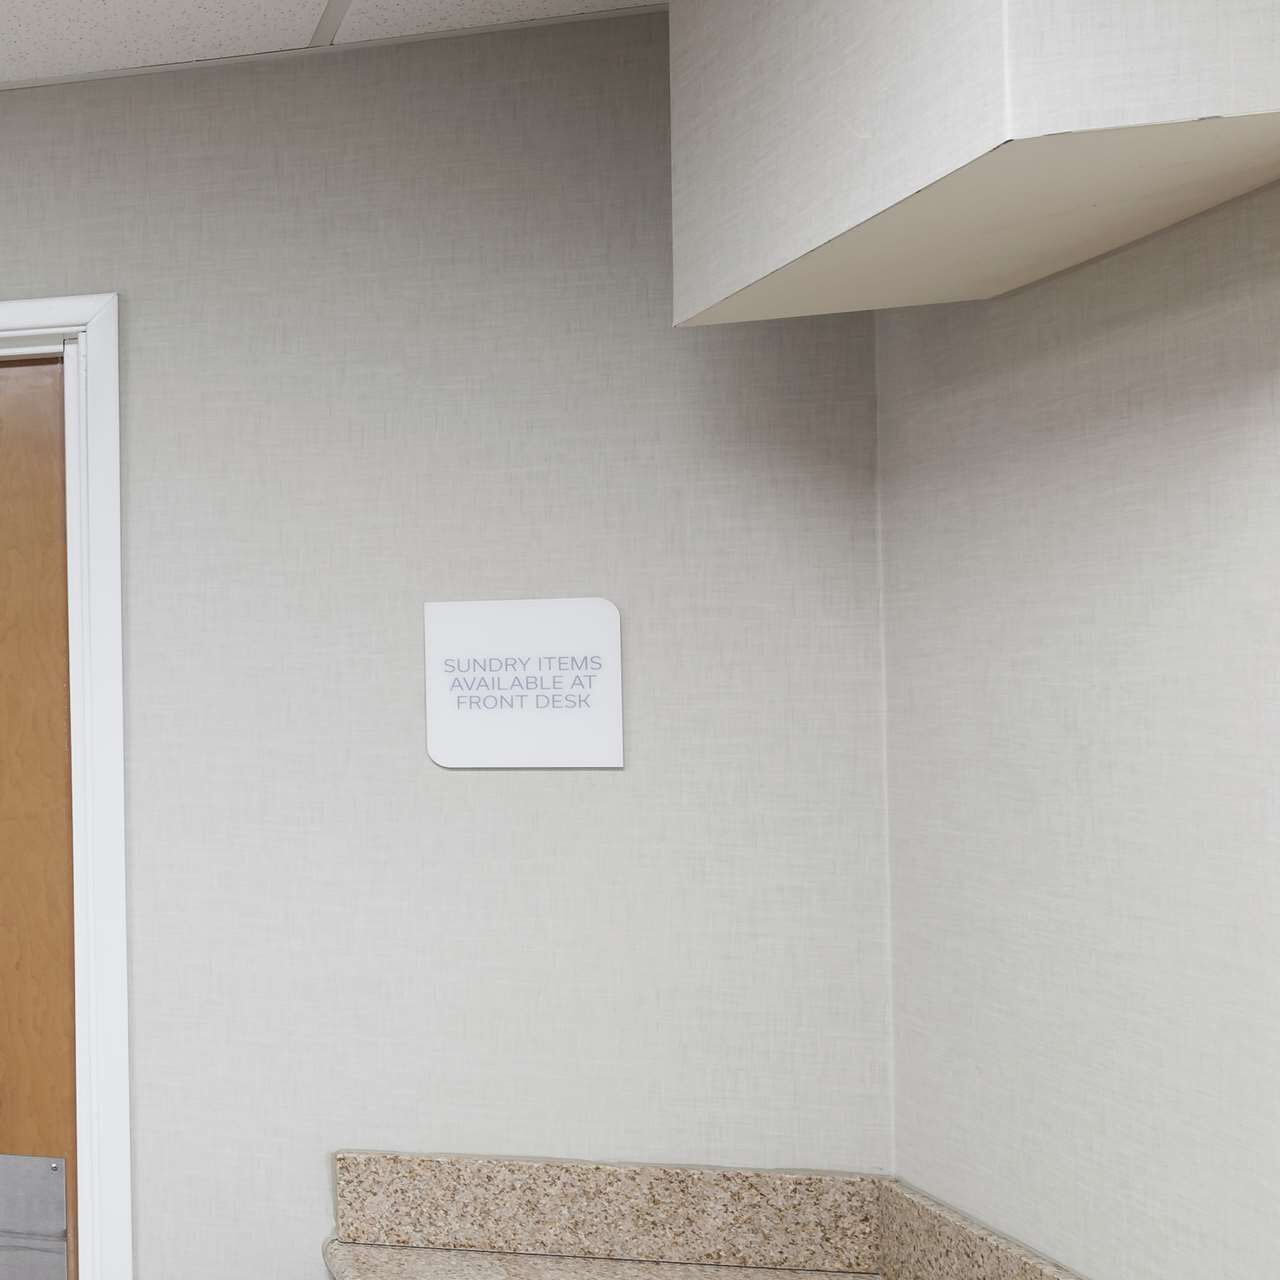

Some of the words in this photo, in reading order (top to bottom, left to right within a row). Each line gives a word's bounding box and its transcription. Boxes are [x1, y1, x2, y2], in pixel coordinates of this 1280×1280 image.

[444, 657, 530, 673] SUNDRY
[538, 655, 602, 671] ITEMS
[449, 675, 564, 691] AVAILABLE
[570, 674, 597, 690] AT
[456, 694, 528, 710] FRONT
[535, 694, 591, 709] DESK
